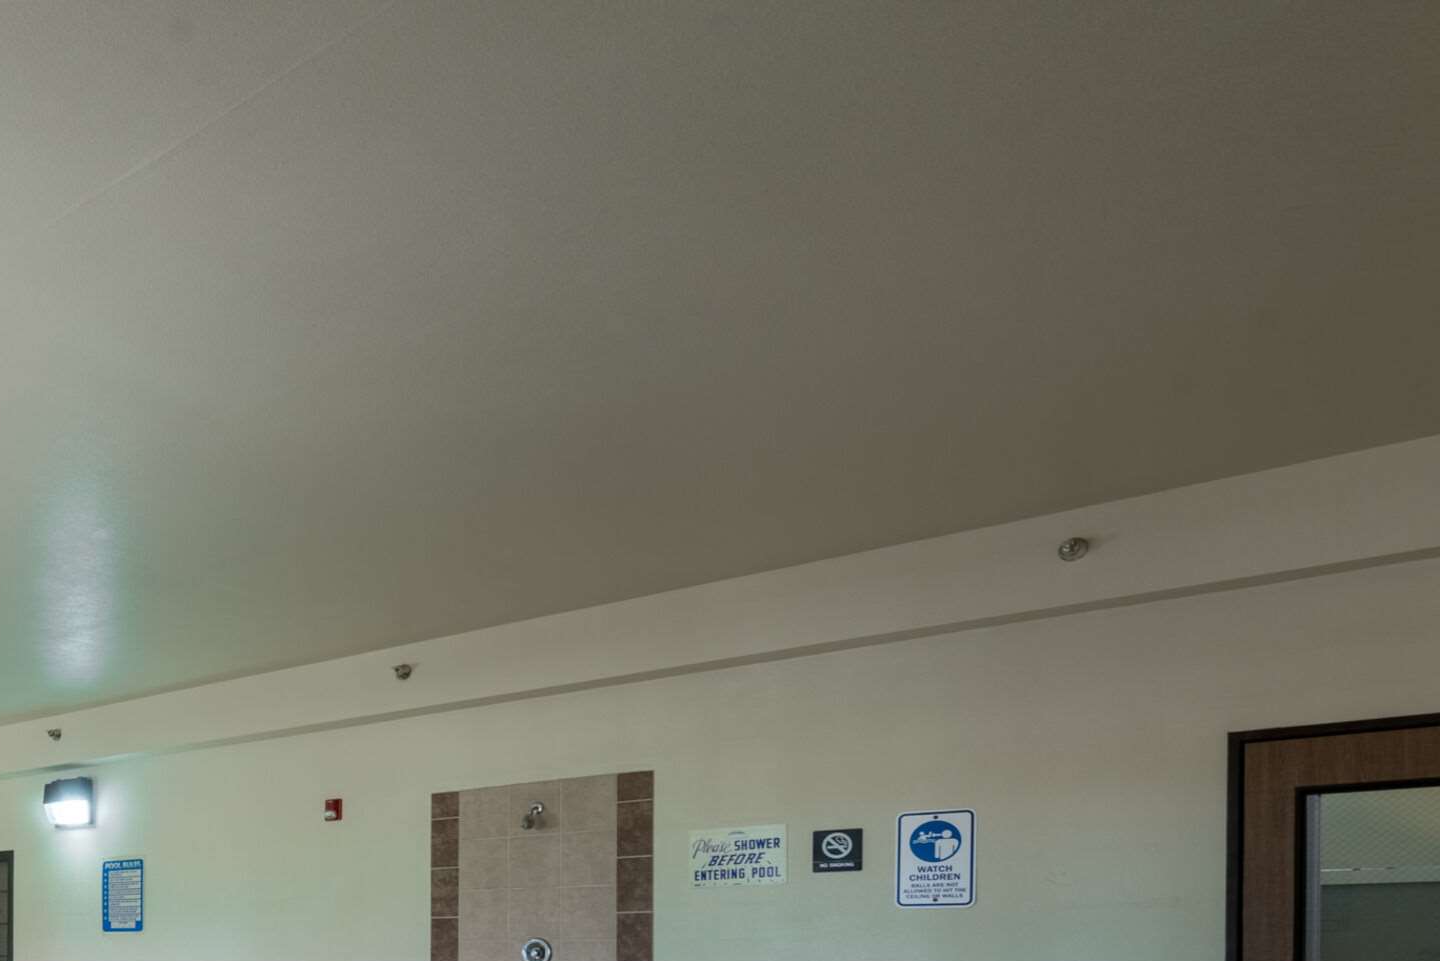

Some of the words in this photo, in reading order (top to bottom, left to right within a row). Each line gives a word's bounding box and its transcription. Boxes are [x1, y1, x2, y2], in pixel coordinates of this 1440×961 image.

[734, 837, 781, 851] SHOWER
[708, 852, 766, 867] BEFORE
[694, 868, 745, 881] ENTERING
[751, 866, 782, 878] POOL
[917, 865, 953, 873] WATCH
[908, 873, 961, 881] CHILDREN
